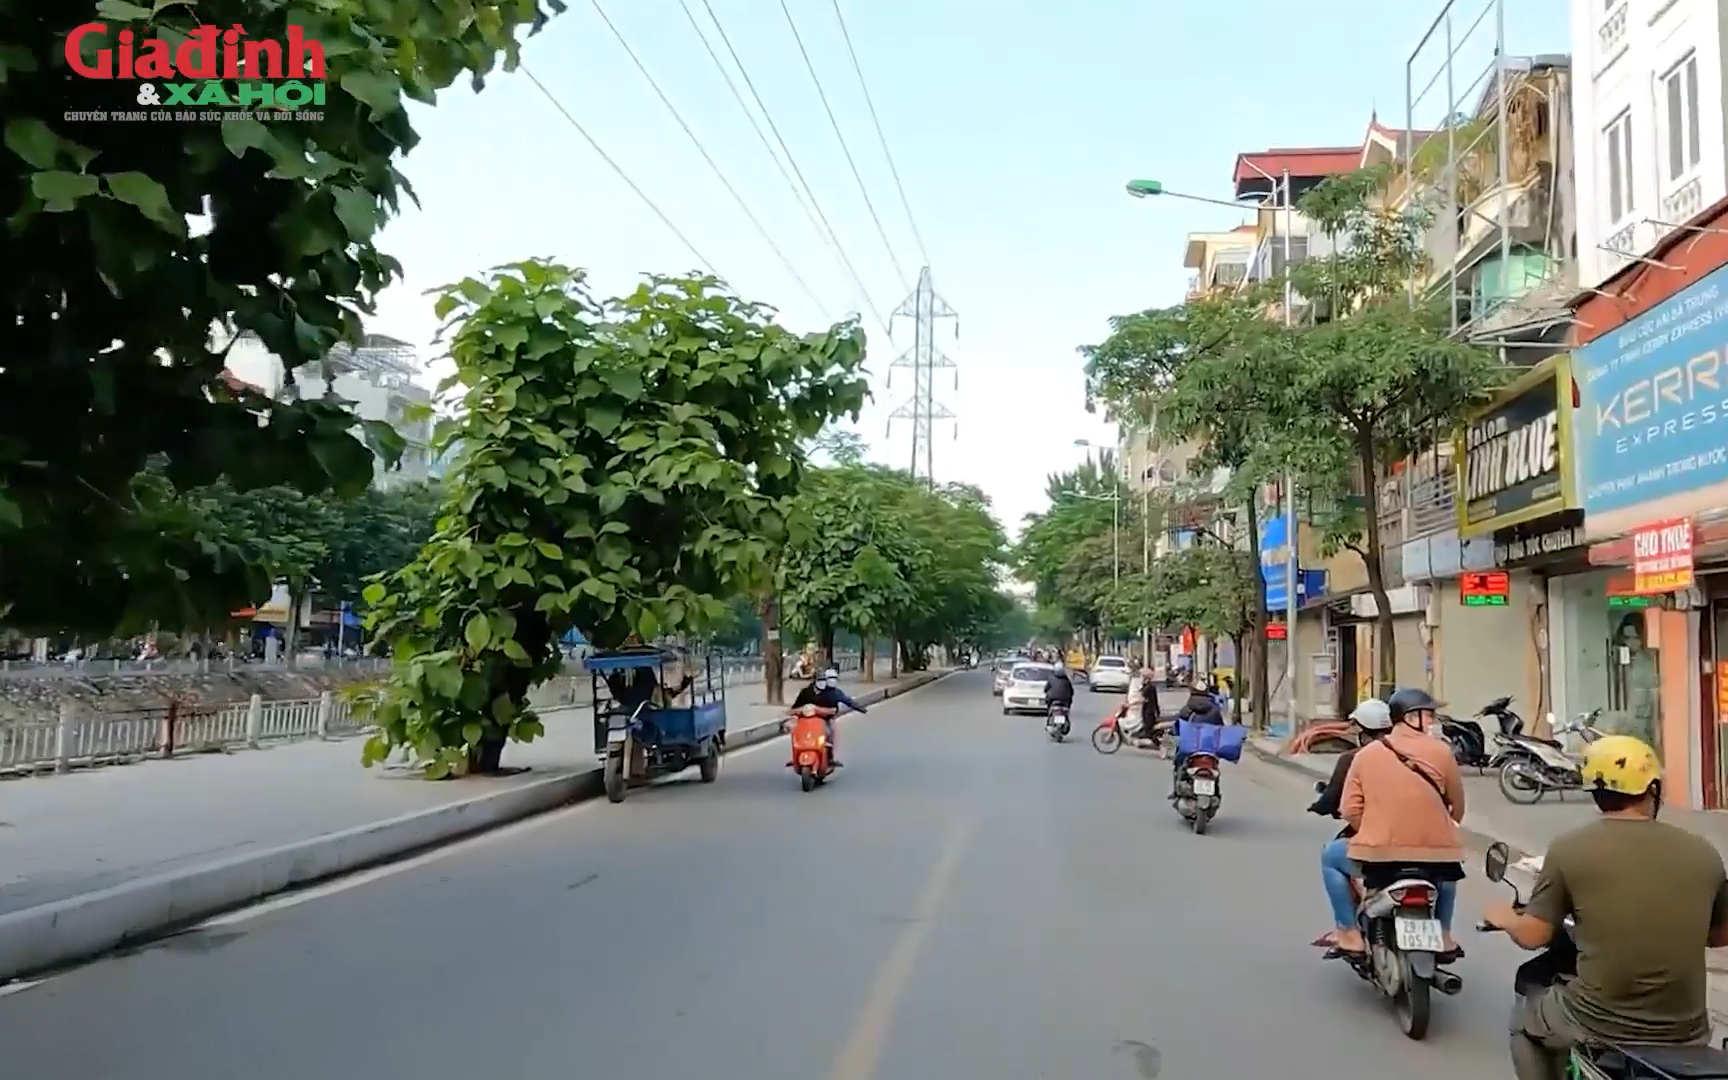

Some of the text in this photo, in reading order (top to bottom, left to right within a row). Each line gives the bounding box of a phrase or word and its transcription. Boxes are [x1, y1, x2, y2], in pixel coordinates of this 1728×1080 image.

[1596, 343, 1728, 437] KERR
[1505, 410, 1558, 487] BLUE
[1635, 530, 1659, 557] CHO
